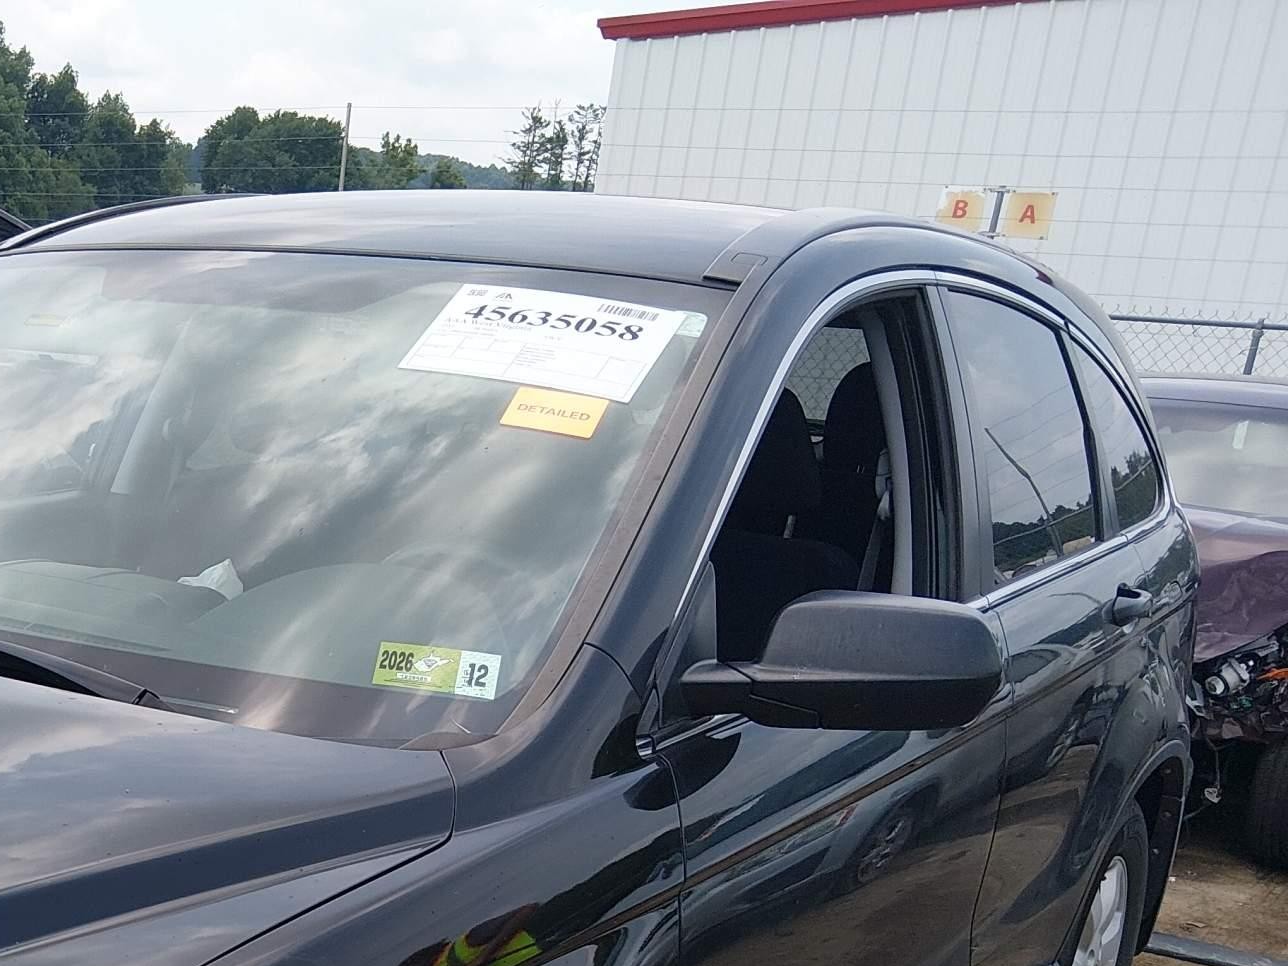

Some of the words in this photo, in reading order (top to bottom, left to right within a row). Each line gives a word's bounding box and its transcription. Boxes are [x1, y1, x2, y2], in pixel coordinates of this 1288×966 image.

[951, 200, 968, 218] B
[1018, 205, 1035, 224] A
[464, 304, 644, 341] 45635058
[516, 403, 591, 421] DETAILED
[379, 650, 414, 672] 2026
[467, 663, 489, 688] 12
